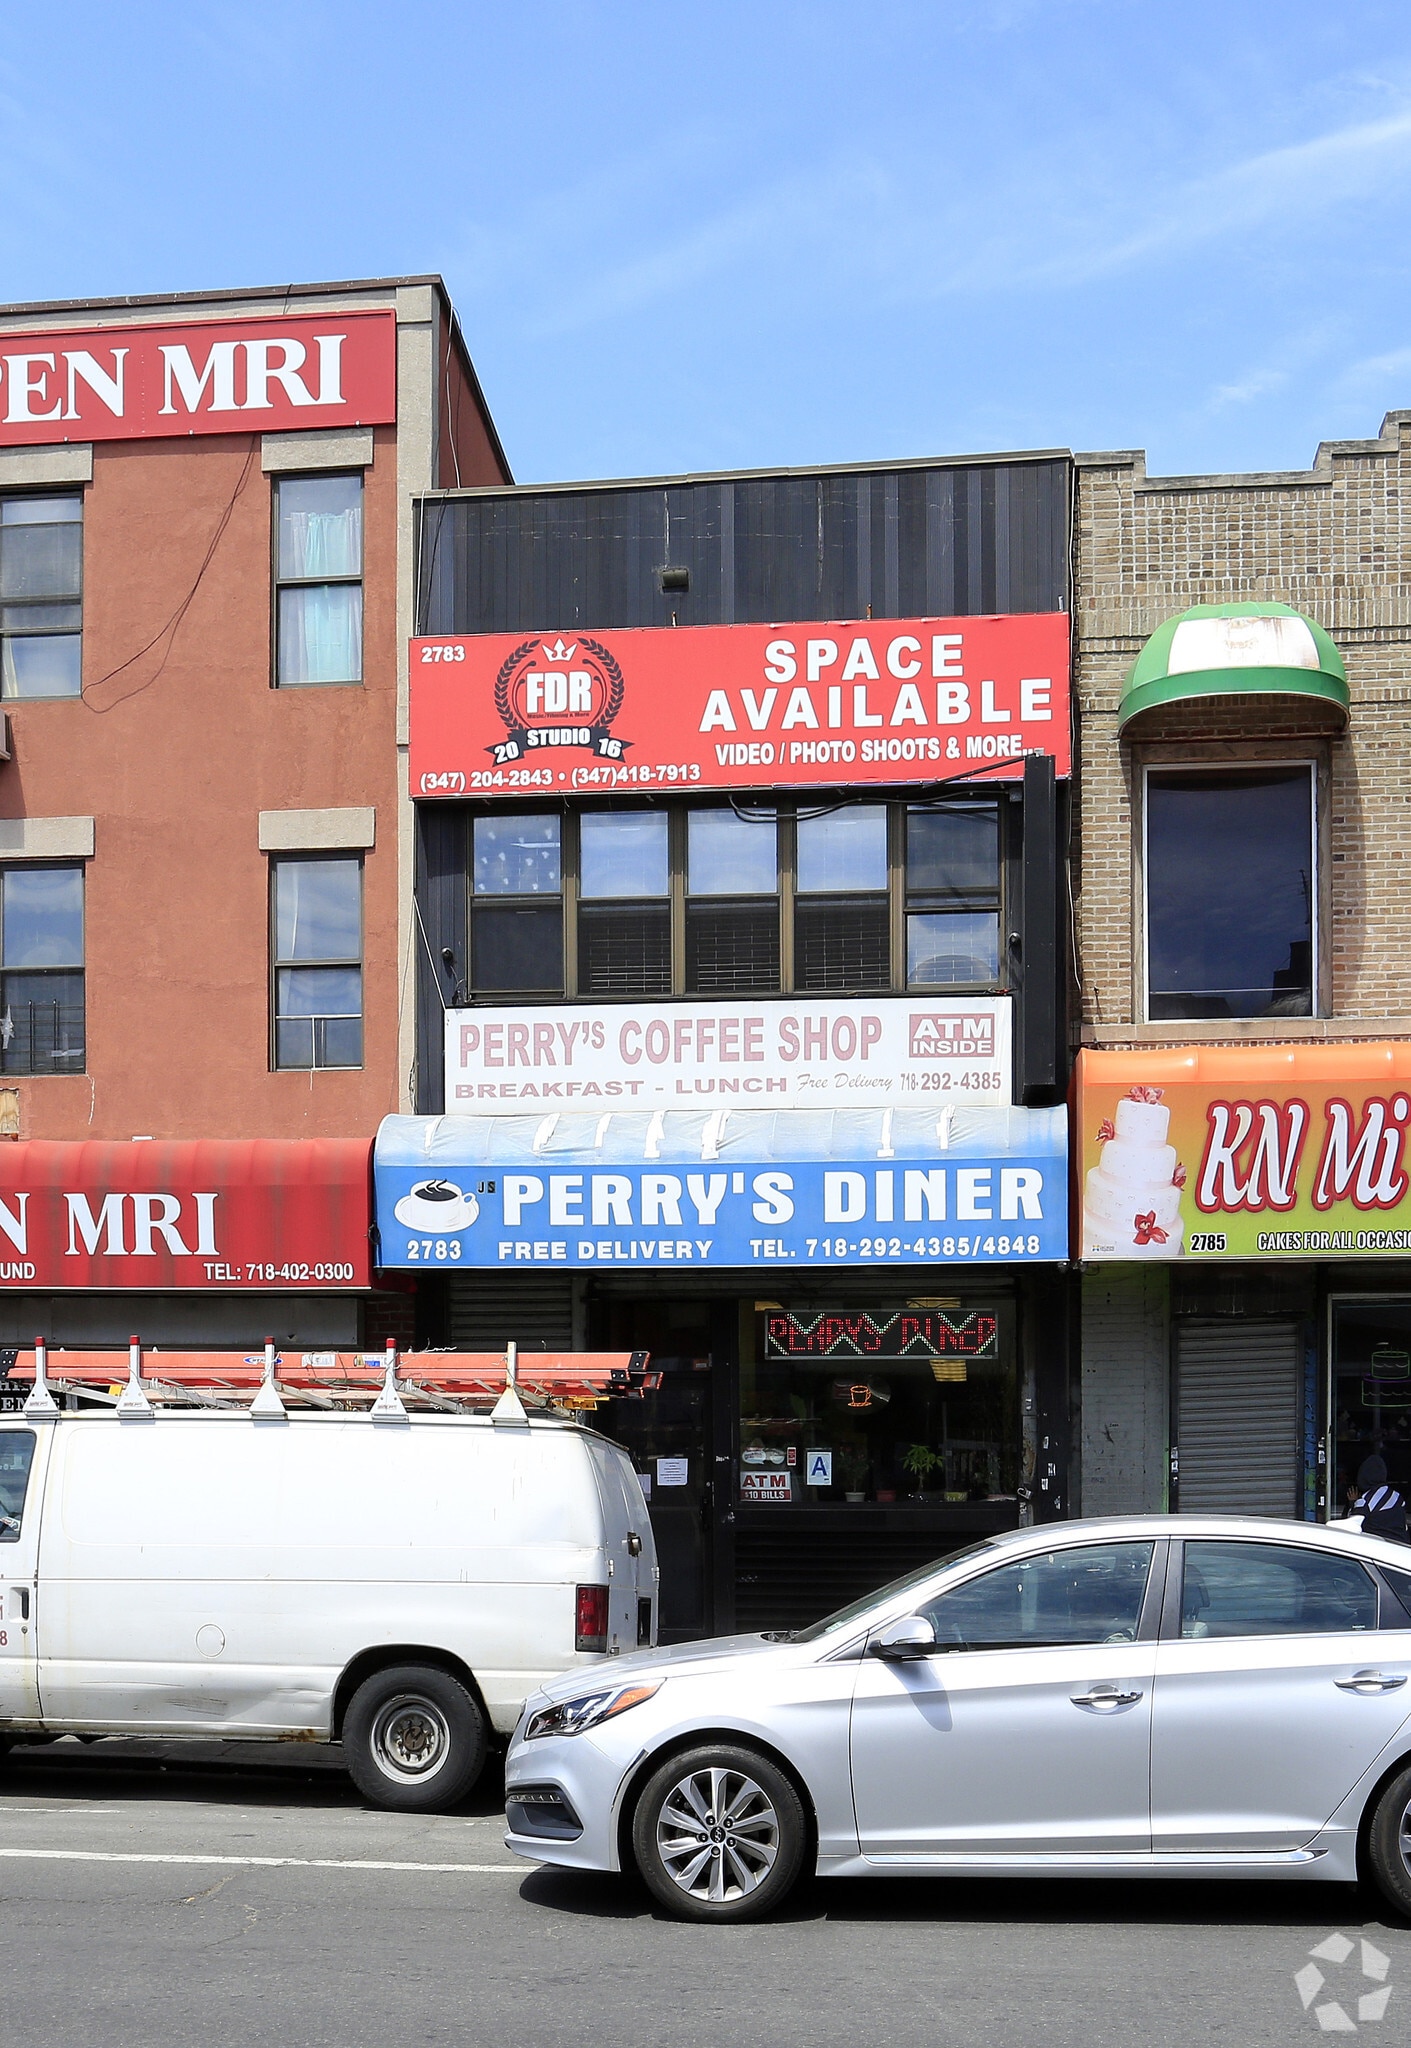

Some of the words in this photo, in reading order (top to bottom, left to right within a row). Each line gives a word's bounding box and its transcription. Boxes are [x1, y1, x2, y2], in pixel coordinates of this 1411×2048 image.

[0, 348, 130, 424] EN
[157, 333, 348, 416] MRI
[420, 645, 466, 663] 2783
[764, 634, 964, 683] SPACE
[525, 671, 592, 714] FDR
[699, 678, 1053, 732] AVAILABLE
[526, 727, 591, 747] STUDIO
[598, 738, 623, 758] 16
[494, 741, 520, 764] 20
[715, 743, 775, 766] VIDEO
[790, 740, 856, 763] PHOTO
[861, 736, 942, 761] SHOOTS
[945, 737, 961, 759] &
[420, 773, 466, 793] (347)
[470, 768, 554, 788] 204-2843
[571, 763, 702, 788] (347)418-7913
[913, 1018, 992, 1038] ATM
[459, 1020, 606, 1068] PERRY'S
[619, 1017, 764, 1065] COFFEE
[777, 1016, 883, 1062] SHOP
[912, 1040, 992, 1054] INSIDE
[455, 1081, 644, 1099] BREAKFAST
[675, 1077, 787, 1095] LUNCH
[796, 1073, 829, 1092] Free
[834, 1072, 893, 1093] Delivery
[1197, 1101, 1308, 1208] KN
[502, 1171, 795, 1226] PERRY'S
[823, 1167, 1044, 1224] DINER
[63, 1192, 221, 1256] MRI
[407, 1240, 462, 1260] 2783
[497, 1240, 567, 1260] FREE
[577, 1240, 713, 1260] DELIVERY
[750, 1239, 796, 1258] TEL.
[805, 1235, 1041, 1257] 718-292-4385/4848
[1190, 1234, 1225, 1251] 2785
[1257, 1232, 1302, 1250] CAKES
[1303, 1232, 1330, 1249] FOR
[1331, 1231, 1355, 1249] ALL
[203, 1263, 241, 1281] TEL:
[246, 1263, 354, 1281] 718-402-0300
[811, 1456, 828, 1476] A
[742, 1475, 786, 1487] ATM
[761, 1491, 785, 1499] BILLS
